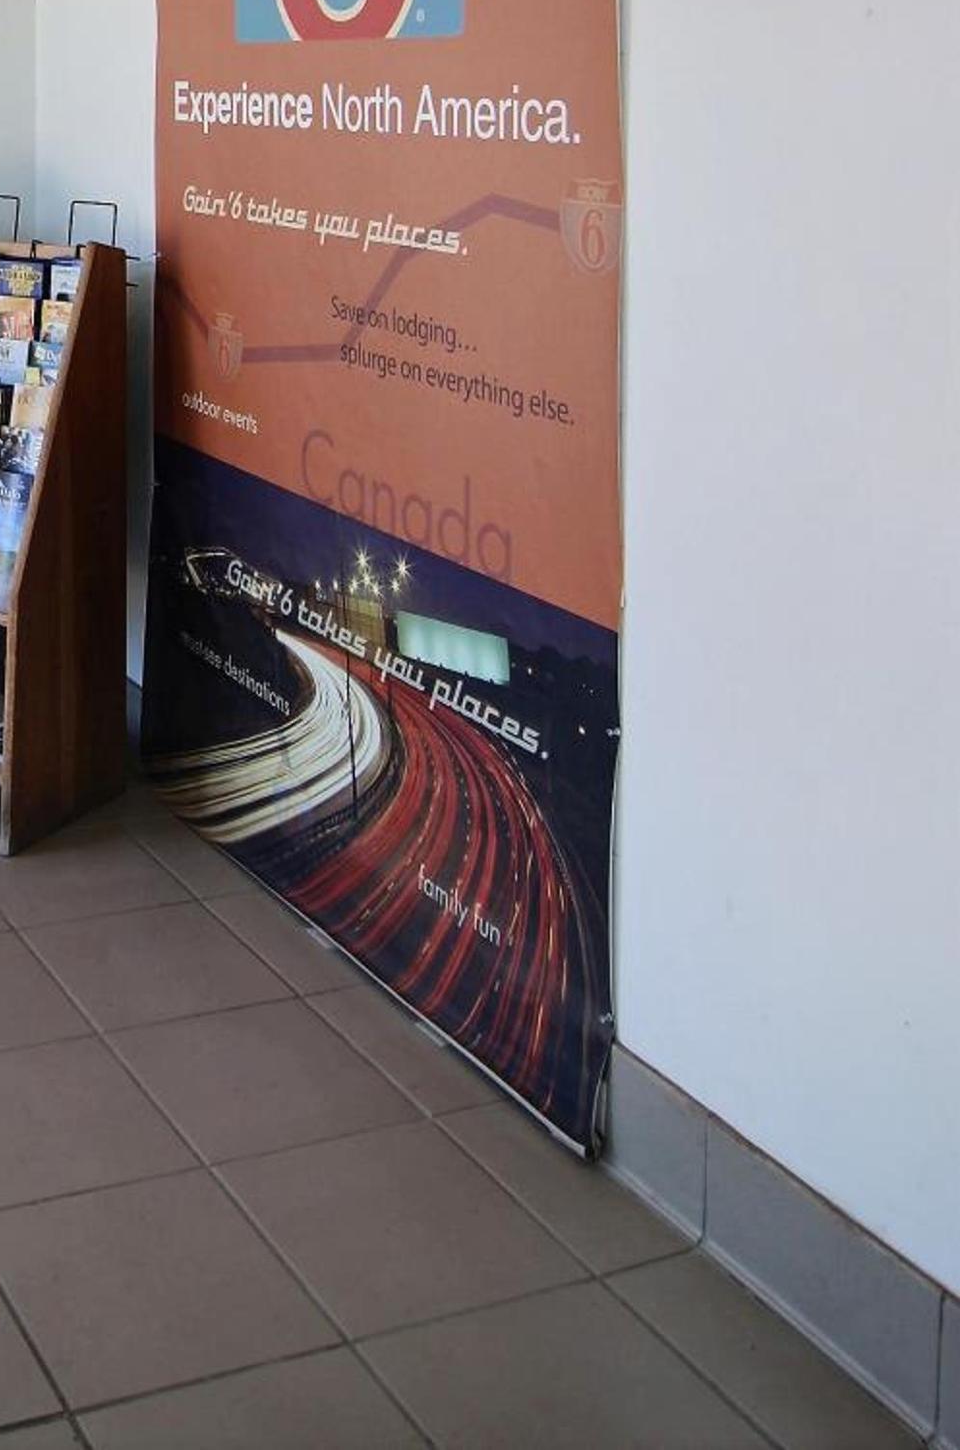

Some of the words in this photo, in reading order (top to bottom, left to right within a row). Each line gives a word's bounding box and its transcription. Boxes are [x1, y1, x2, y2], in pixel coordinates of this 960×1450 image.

[173, 81, 313, 133] Experience
[322, 83, 403, 134] North
[413, 84, 581, 144] America.
[246, 197, 307, 229] takes
[314, 212, 359, 246] you
[364, 214, 468, 256] places.
[331, 296, 366, 325] Save
[367, 307, 389, 330] on
[392, 309, 478, 353] lodging...
[182, 391, 221, 422] outdoor
[222, 406, 259, 435] events
[339, 341, 397, 378] splurge
[400, 361, 423, 383] on
[425, 365, 525, 417] everything
[529, 390, 575, 427] else.
[301, 429, 514, 584] Canada
[223, 653, 291, 717] destinations
[297, 600, 368, 658] takes
[373, 647, 426, 691] you
[428, 678, 549, 760] places.
[417, 866, 469, 928] family
[472, 902, 502, 947] fun
